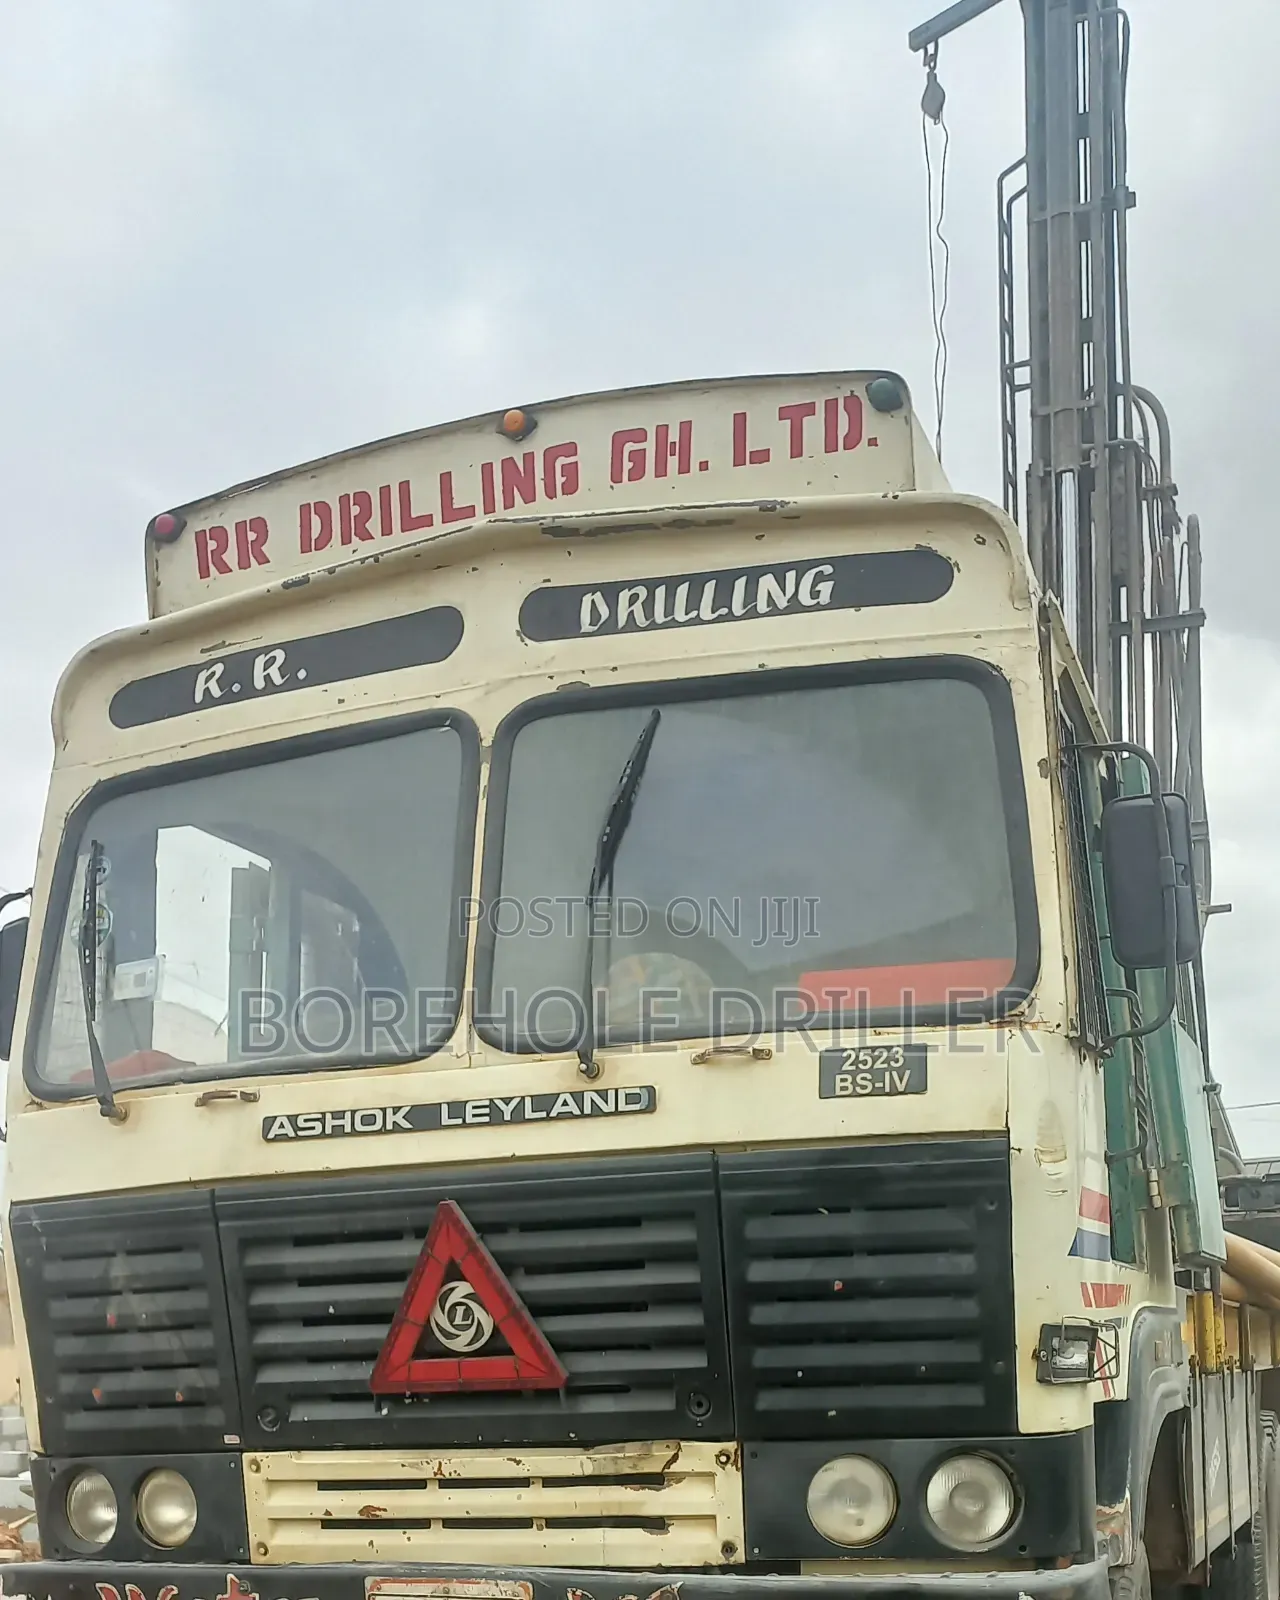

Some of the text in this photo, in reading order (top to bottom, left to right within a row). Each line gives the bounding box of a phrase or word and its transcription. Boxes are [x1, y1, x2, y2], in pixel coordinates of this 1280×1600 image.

[194, 394, 879, 579] RR DRILLING GH. LTD.
[579, 563, 836, 634] DRILLING
[841, 1046, 905, 1071] 2523
[834, 1069, 912, 1096] BS-IV
[265, 1086, 650, 1140] ASHOK LEYLAND
[452, 1304, 474, 1326] L
